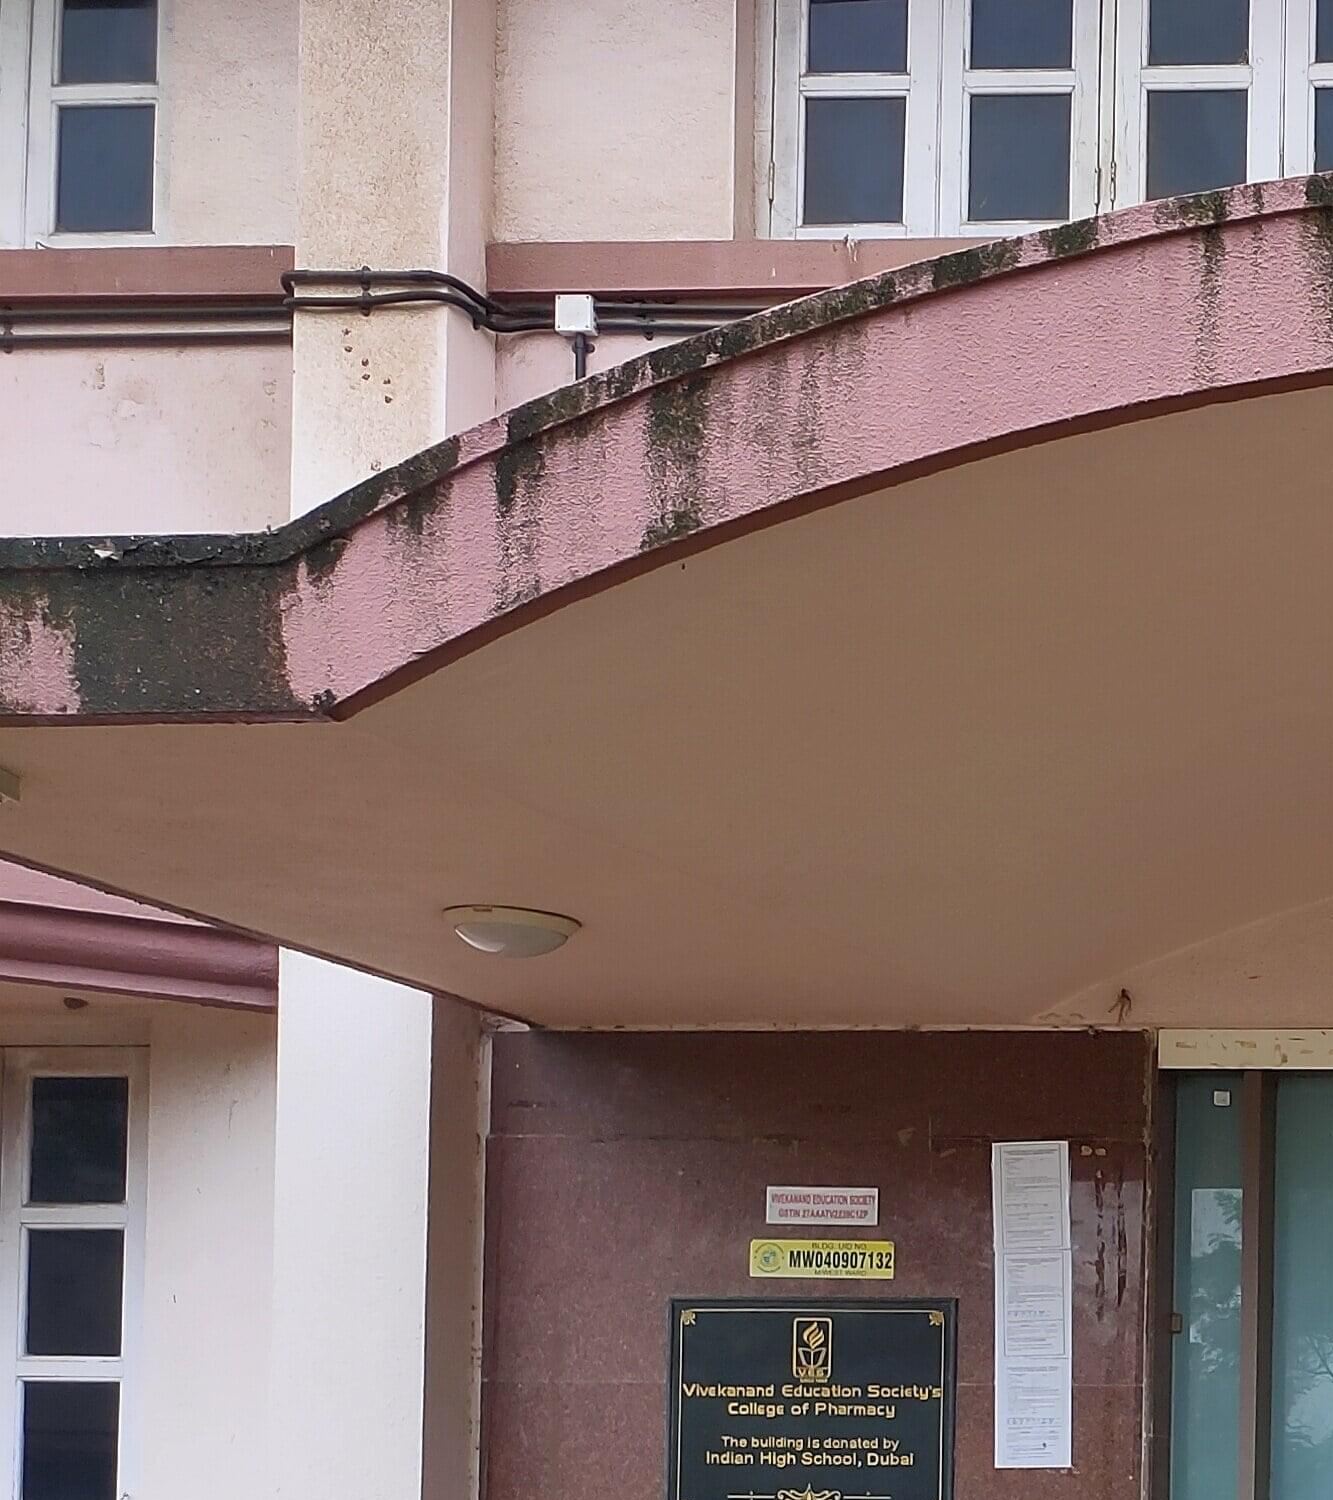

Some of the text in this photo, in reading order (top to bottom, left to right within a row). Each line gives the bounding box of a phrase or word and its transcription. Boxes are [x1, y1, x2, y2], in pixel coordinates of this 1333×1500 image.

[813, 1194, 848, 1206] EDUCATION
[849, 1195, 876, 1207] SOCIETY
[789, 1250, 893, 1270] MW040907132
[682, 1383, 942, 1400] Vivekanand Education Society's
[727, 1402, 896, 1418] College of Pharmacy
[721, 1435, 900, 1452] The building is donated by
[705, 1452, 915, 1468] Indian High School, Dubai
